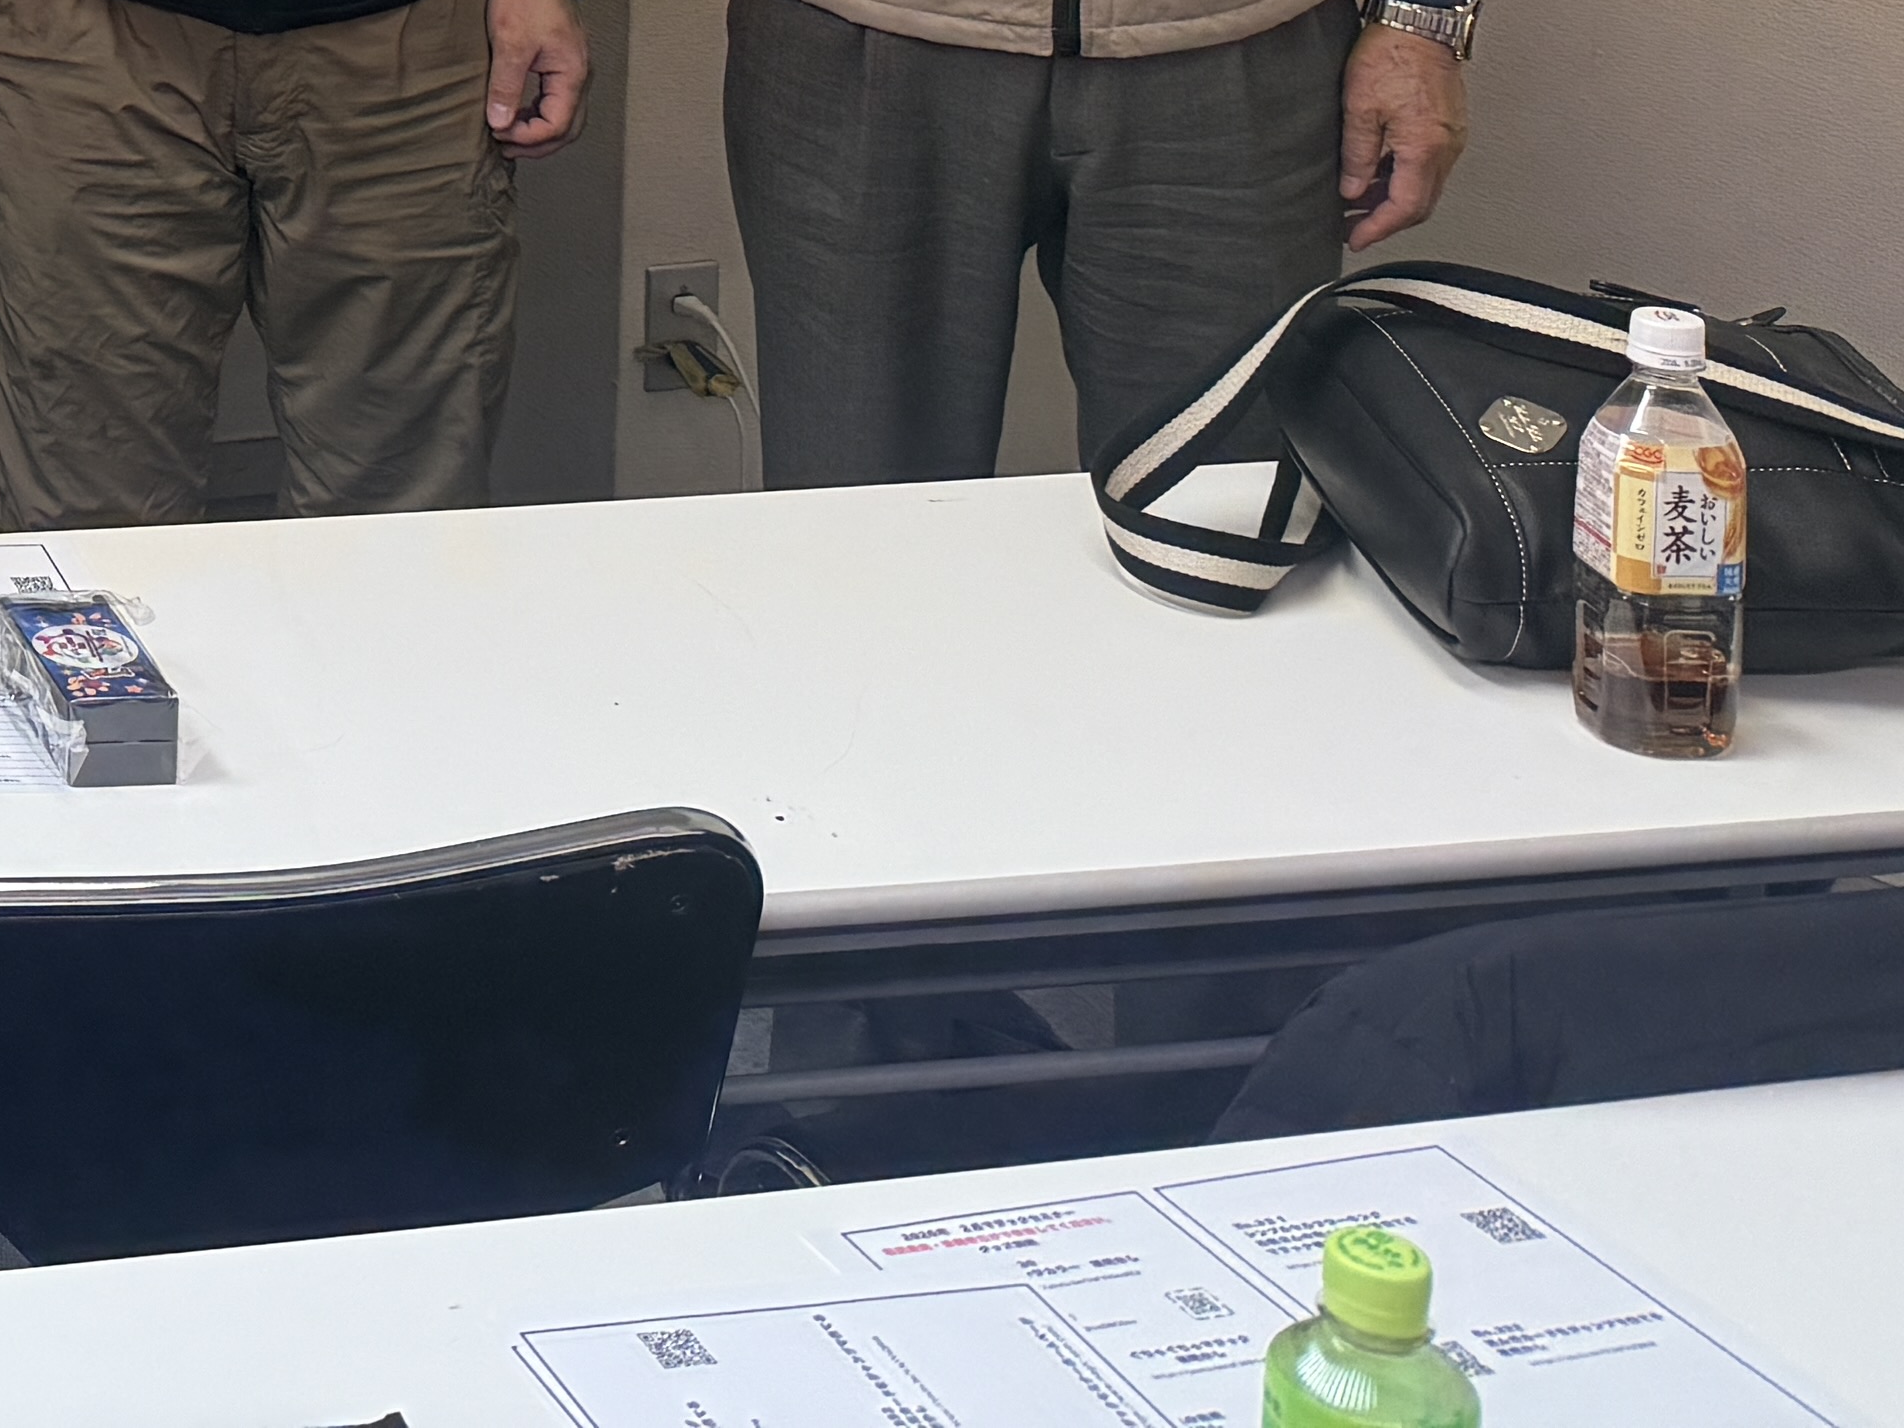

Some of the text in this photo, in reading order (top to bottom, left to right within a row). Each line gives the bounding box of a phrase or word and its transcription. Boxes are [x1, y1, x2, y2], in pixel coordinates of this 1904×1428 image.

[1660, 484, 1698, 566] 麦茶
[1699, 493, 1718, 562] おいしい
